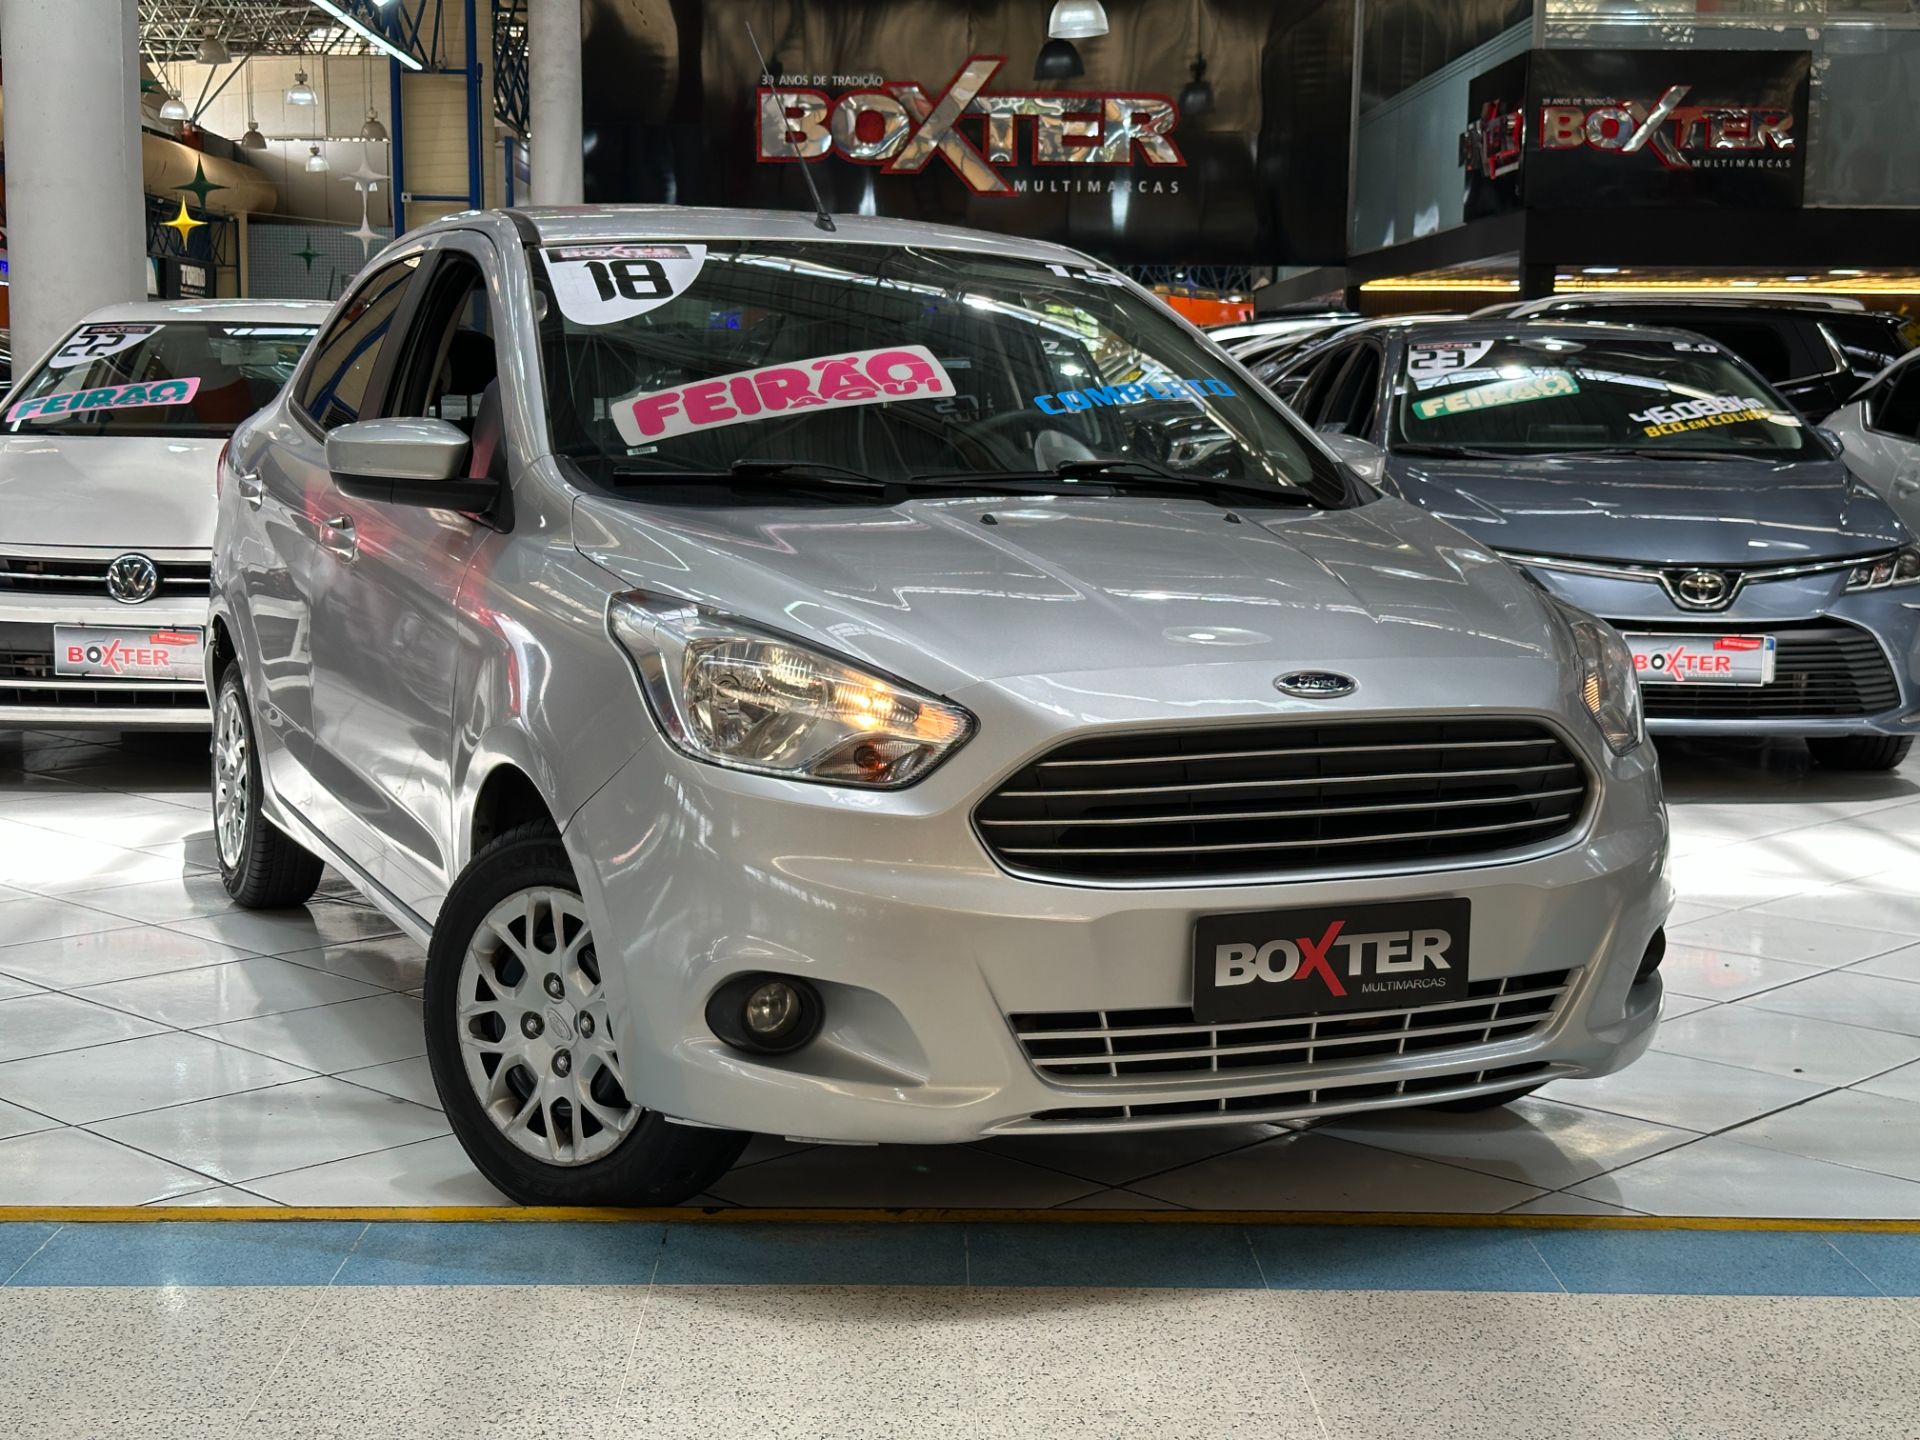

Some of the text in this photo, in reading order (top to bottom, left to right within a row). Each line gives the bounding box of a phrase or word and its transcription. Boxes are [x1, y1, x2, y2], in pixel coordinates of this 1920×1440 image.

[779, 75, 809, 86] ANOS
[813, 75, 827, 85] DE
[832, 73, 884, 88] TRADIÇÃO
[756, 55, 1187, 196] BOXTER
[1540, 84, 1796, 170] BOXTER
[1691, 159, 1793, 169] MULTIMARCAS
[1013, 179, 1180, 194] MULTIMARCAS
[584, 259, 675, 302] 18
[57, 334, 127, 357] 22
[1410, 349, 1466, 370] 23
[1671, 341, 1718, 354] 2.0
[15, 380, 190, 419] FEIRÃO
[631, 351, 936, 437] FEIRÃO
[787, 377, 943, 410] AQUI
[1033, 378, 1238, 416] COMPLETO
[67, 639, 171, 674] BOXTER
[1634, 645, 1731, 682] BOXTER
[1214, 920, 1452, 997] BOXTER
[1361, 977, 1447, 993] MULTIMARCAS
